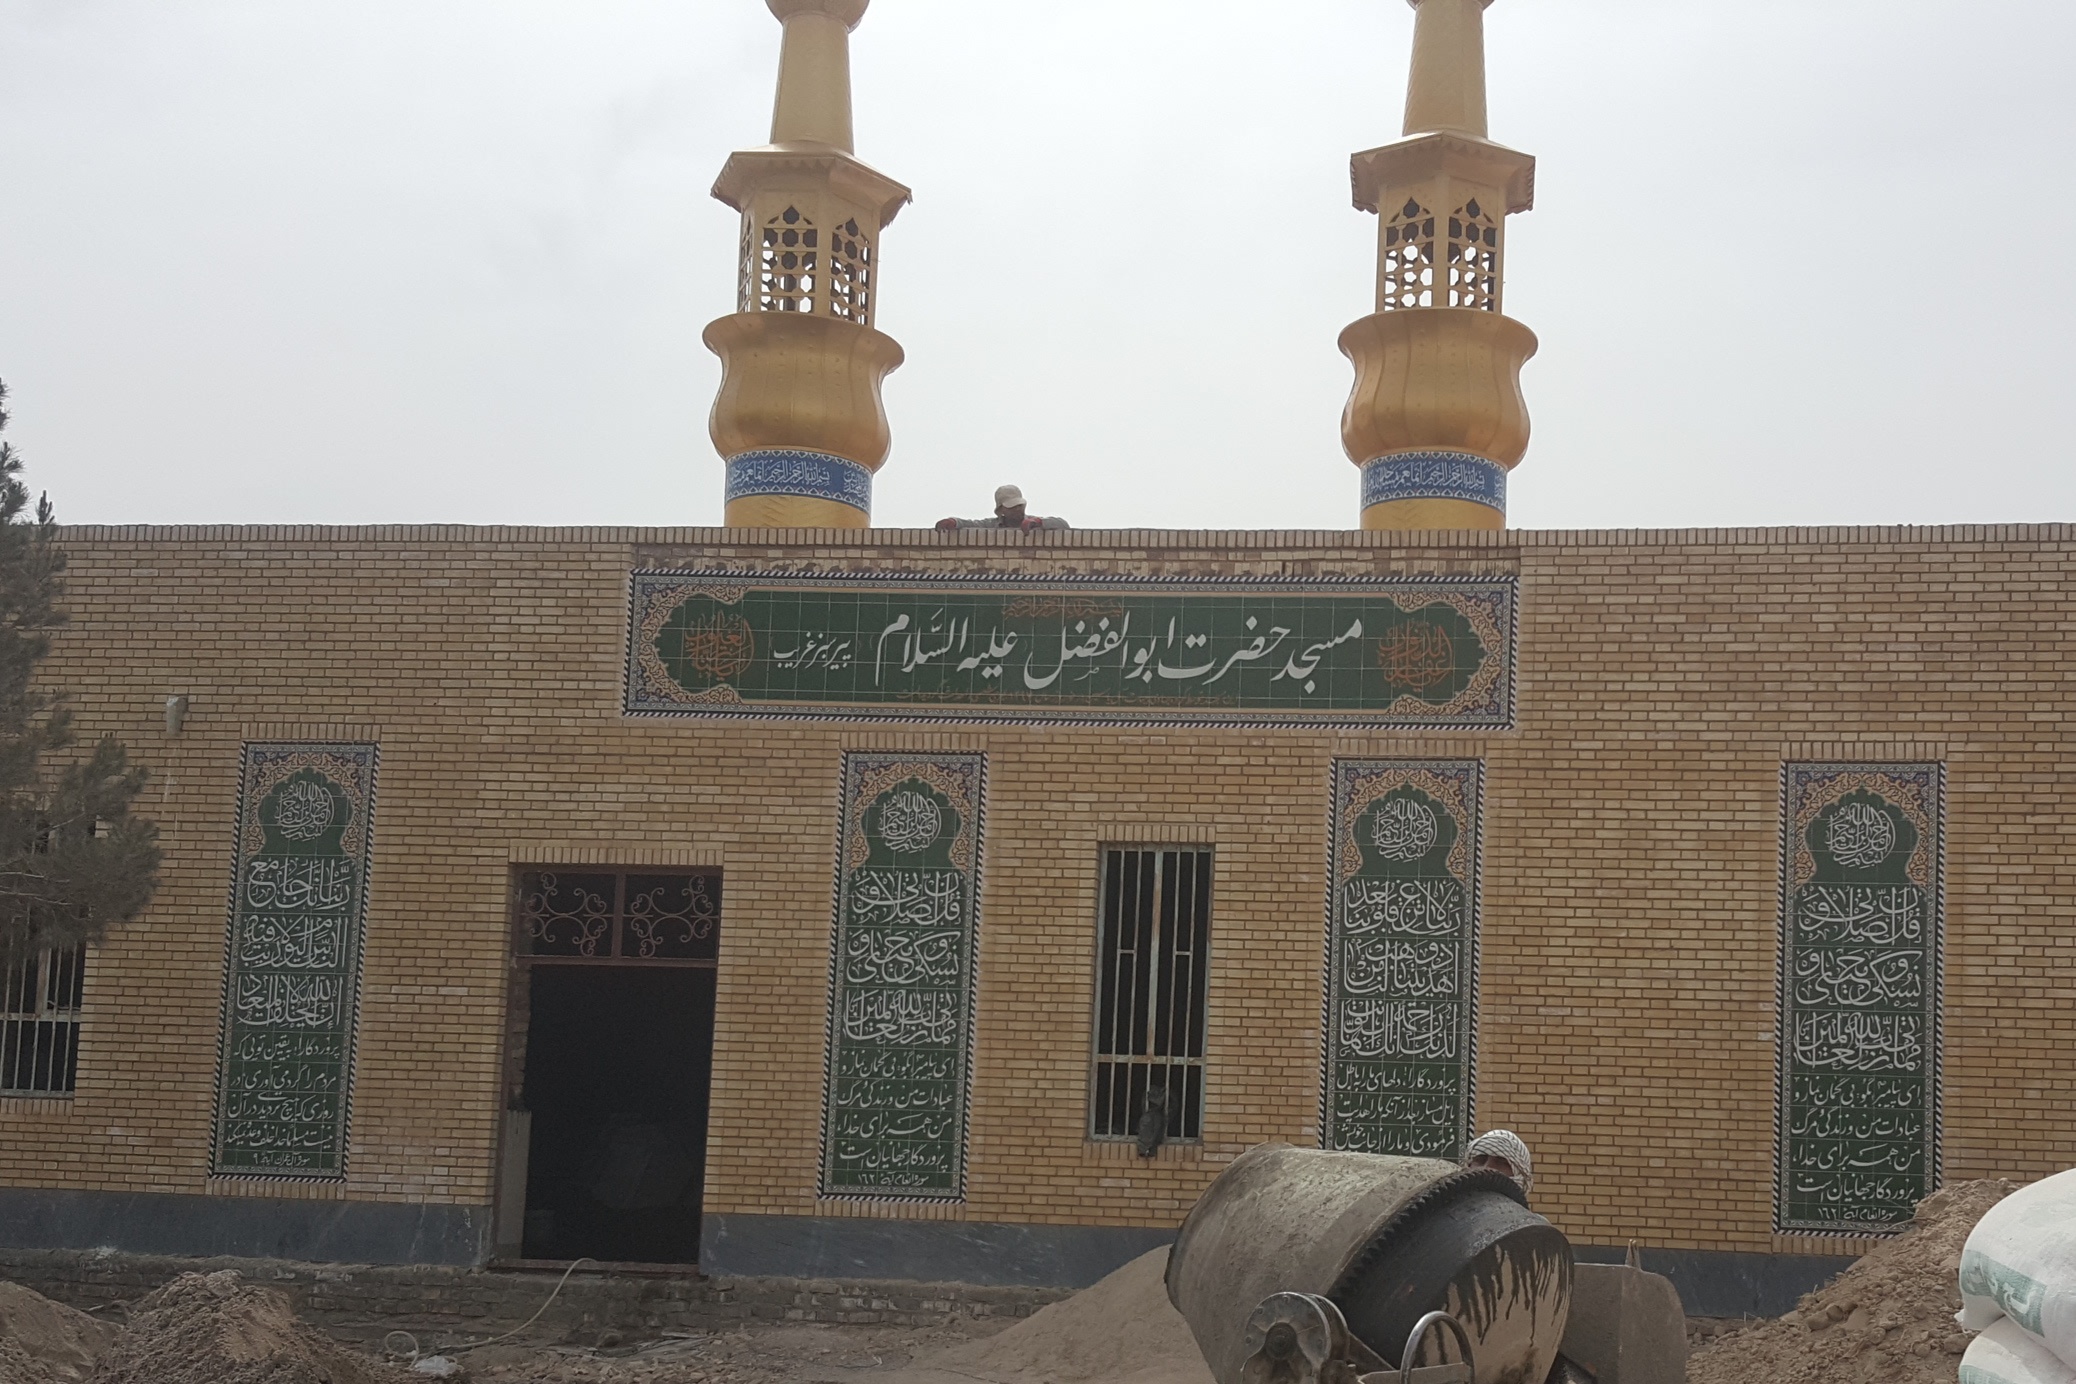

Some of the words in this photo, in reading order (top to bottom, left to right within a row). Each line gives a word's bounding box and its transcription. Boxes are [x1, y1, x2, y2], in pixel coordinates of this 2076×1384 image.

[773, 630, 818, 670] غریب
[956, 624, 1018, 679] علیه
[1023, 610, 1176, 690] ابوالفضل
[1157, 615, 1292, 687] حضرت
[1270, 618, 1363, 694] مسجد
[837, 1080, 862, 1107] مرگ
[895, 1085, 919, 1109] من
[912, 1084, 953, 1111] عبادات
[860, 1111, 890, 1139] برای
[886, 1113, 933, 1136] همه
[927, 1115, 953, 1139] من
[1790, 1107, 1818, 1136] مرگ
[1854, 1113, 1882, 1139] من
[1875, 1111, 1921, 1141] عبادات
[1411, 1127, 1455, 1154] فرمودی
[1846, 1142, 1899, 1167] همه
[253, 1152, 259, 1165] ۹
[839, 1146, 872, 1171] است
[866, 1141, 912, 1169] جهانیان
[902, 1143, 948, 1172] پروردگار
[1817, 1140, 1851, 1170] برای
[1893, 1145, 1921, 1171] من
[1796, 1172, 1834, 1203] است
[1826, 1173, 1876, 1202] جهانیان
[1867, 1176, 1920, 1208] پروردگار
